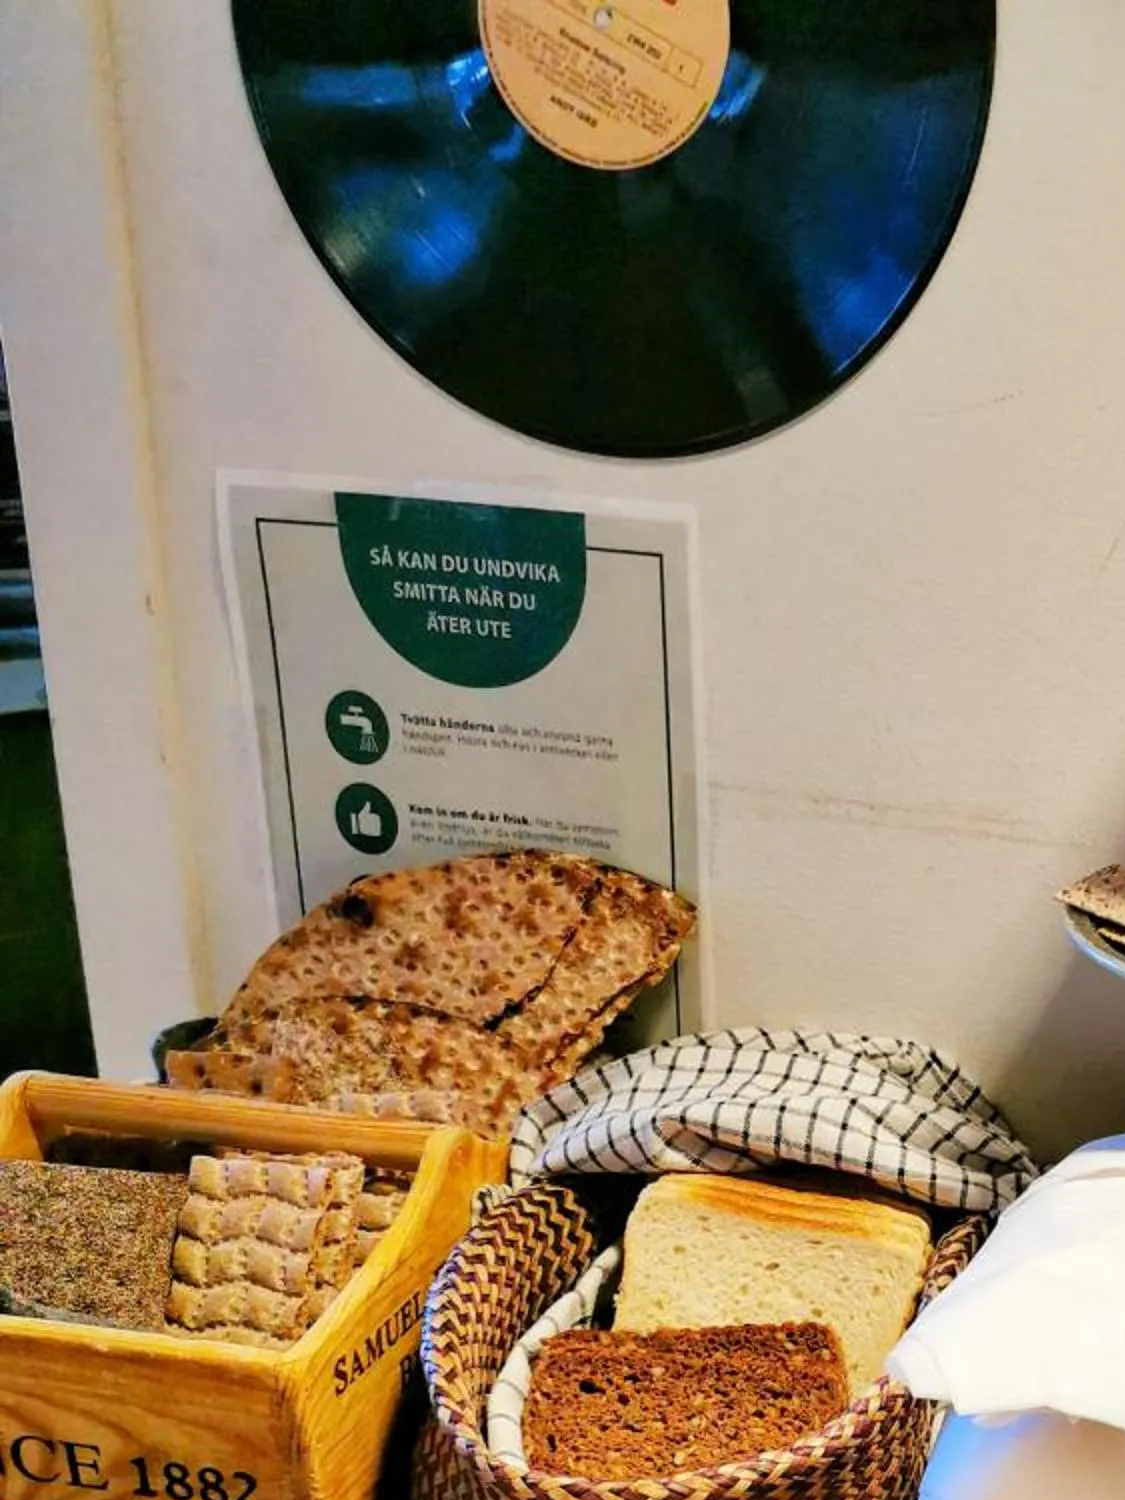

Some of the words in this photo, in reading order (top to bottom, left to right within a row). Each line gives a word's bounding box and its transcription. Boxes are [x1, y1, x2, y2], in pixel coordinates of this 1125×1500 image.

[369, 544, 394, 567] SÅ
[398, 550, 437, 571] KAN
[441, 555, 469, 574] DU
[473, 558, 561, 583] UNDVIKA
[393, 580, 461, 604] SMITTA
[465, 585, 505, 609] NÄR
[509, 592, 536, 611] DU
[427, 610, 473, 635] ÄTER
[476, 618, 513, 639] UTE
[0, 1434, 110, 1491] CE
